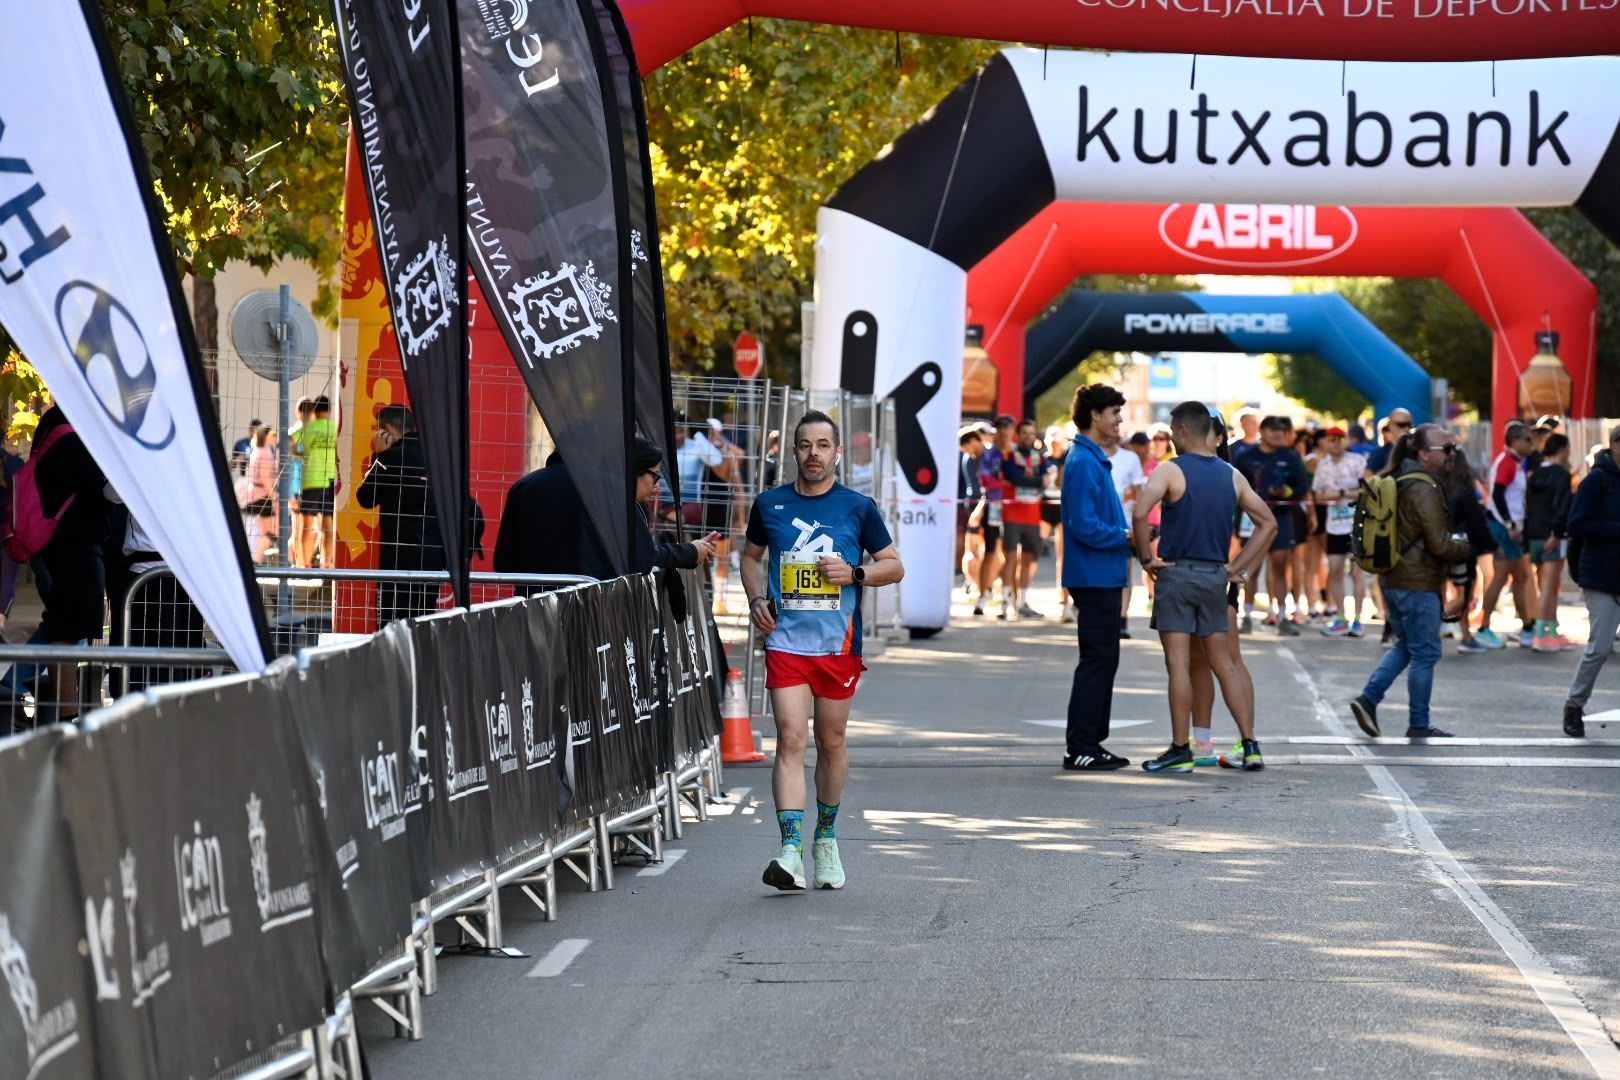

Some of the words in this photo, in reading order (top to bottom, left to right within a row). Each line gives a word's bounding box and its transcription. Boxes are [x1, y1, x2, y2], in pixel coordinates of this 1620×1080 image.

[1414, 0, 1619, 18] DEPO
[1076, 85, 1572, 168] kutxabank
[1185, 203, 1334, 250] ABRIL
[1124, 313, 1290, 334] POWERADE
